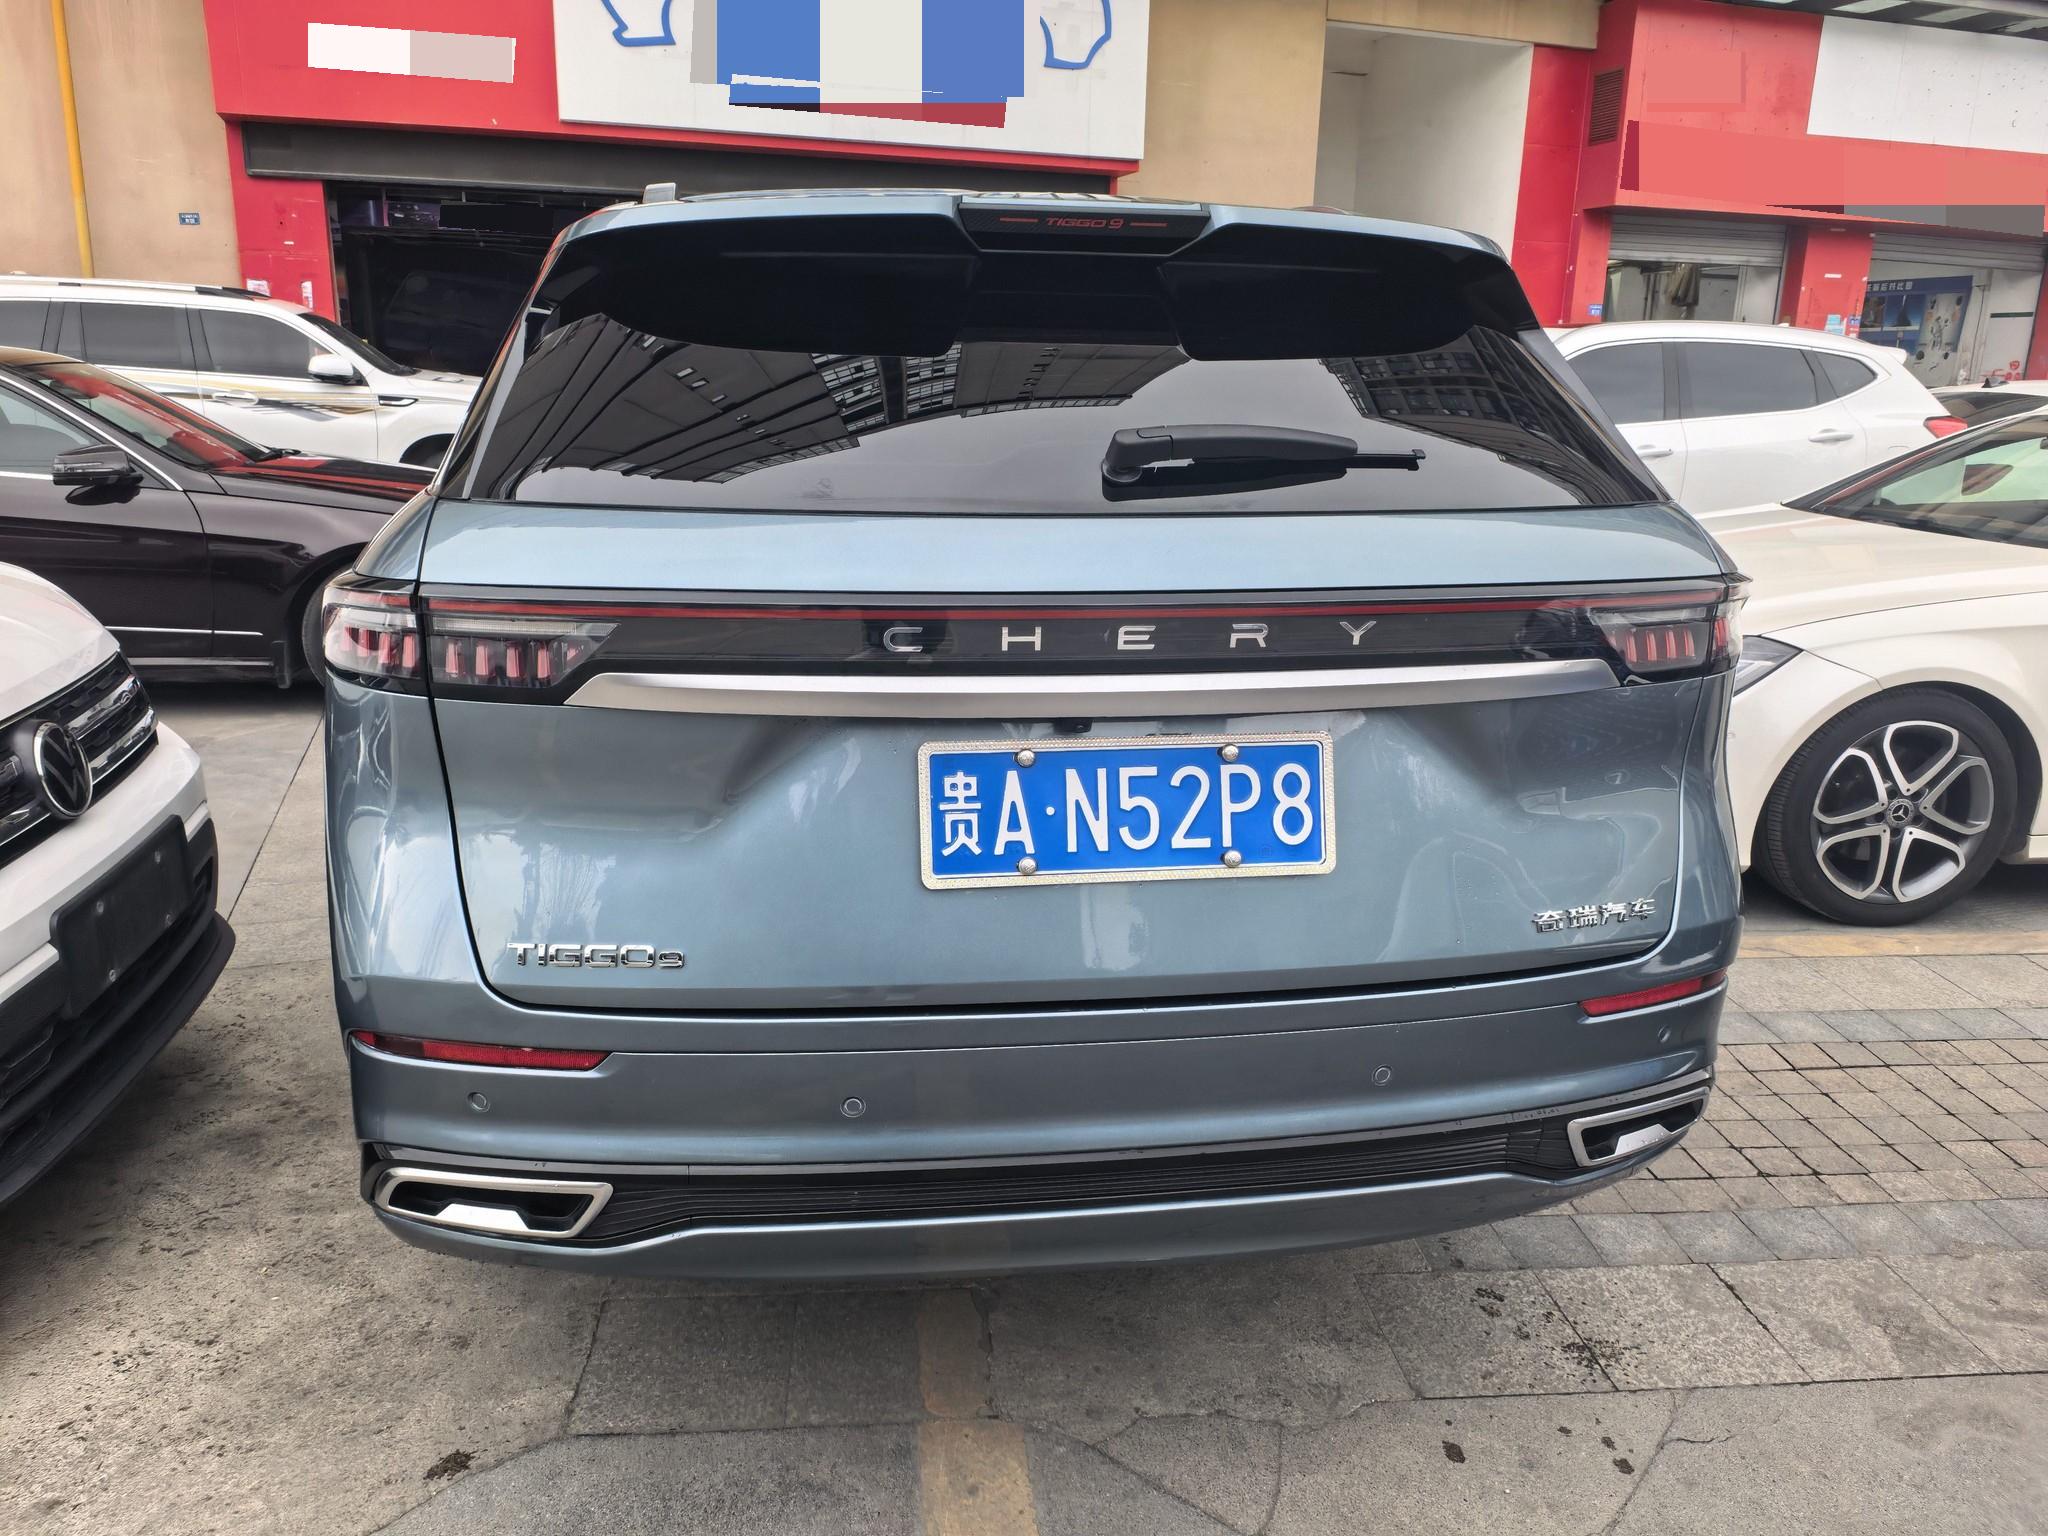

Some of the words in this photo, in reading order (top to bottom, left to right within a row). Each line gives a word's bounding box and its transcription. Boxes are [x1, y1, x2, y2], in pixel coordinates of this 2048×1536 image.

[883, 621, 1376, 653] CHERY
[1533, 898, 1656, 932] 奇瑞汽车
